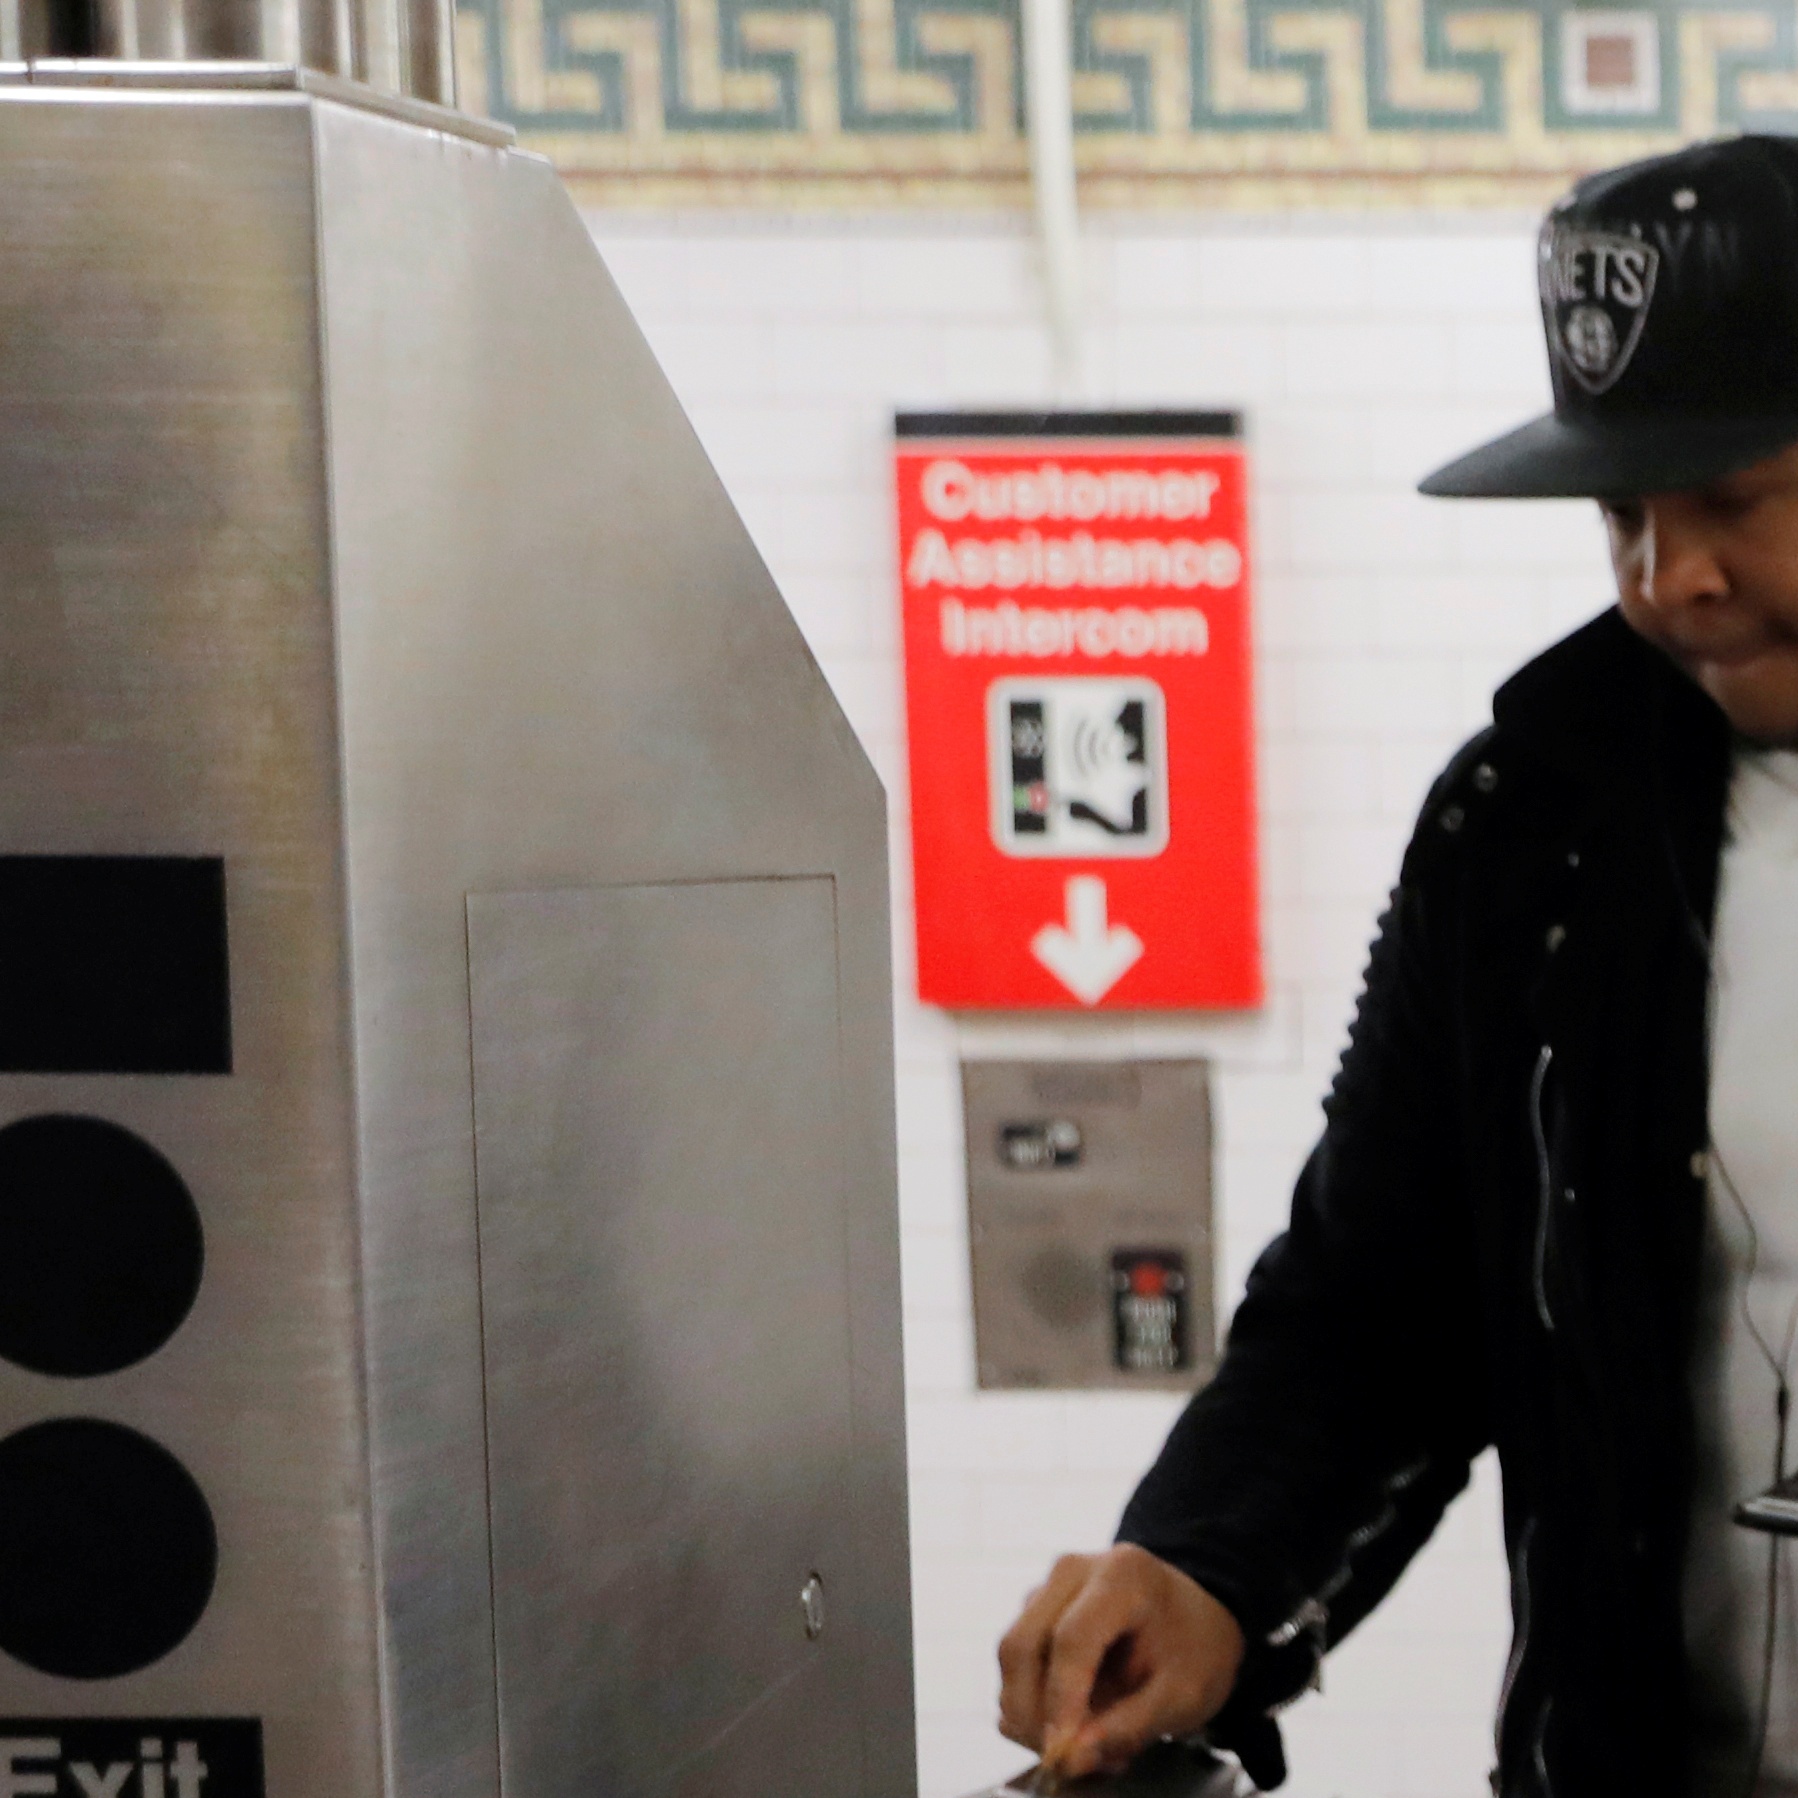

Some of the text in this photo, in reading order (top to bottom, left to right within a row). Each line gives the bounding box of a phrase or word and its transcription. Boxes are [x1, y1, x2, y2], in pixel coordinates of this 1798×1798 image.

[921, 459, 1220, 520] Customer
[908, 528, 1242, 588] Assistance
[940, 596, 1209, 657] Intercom
